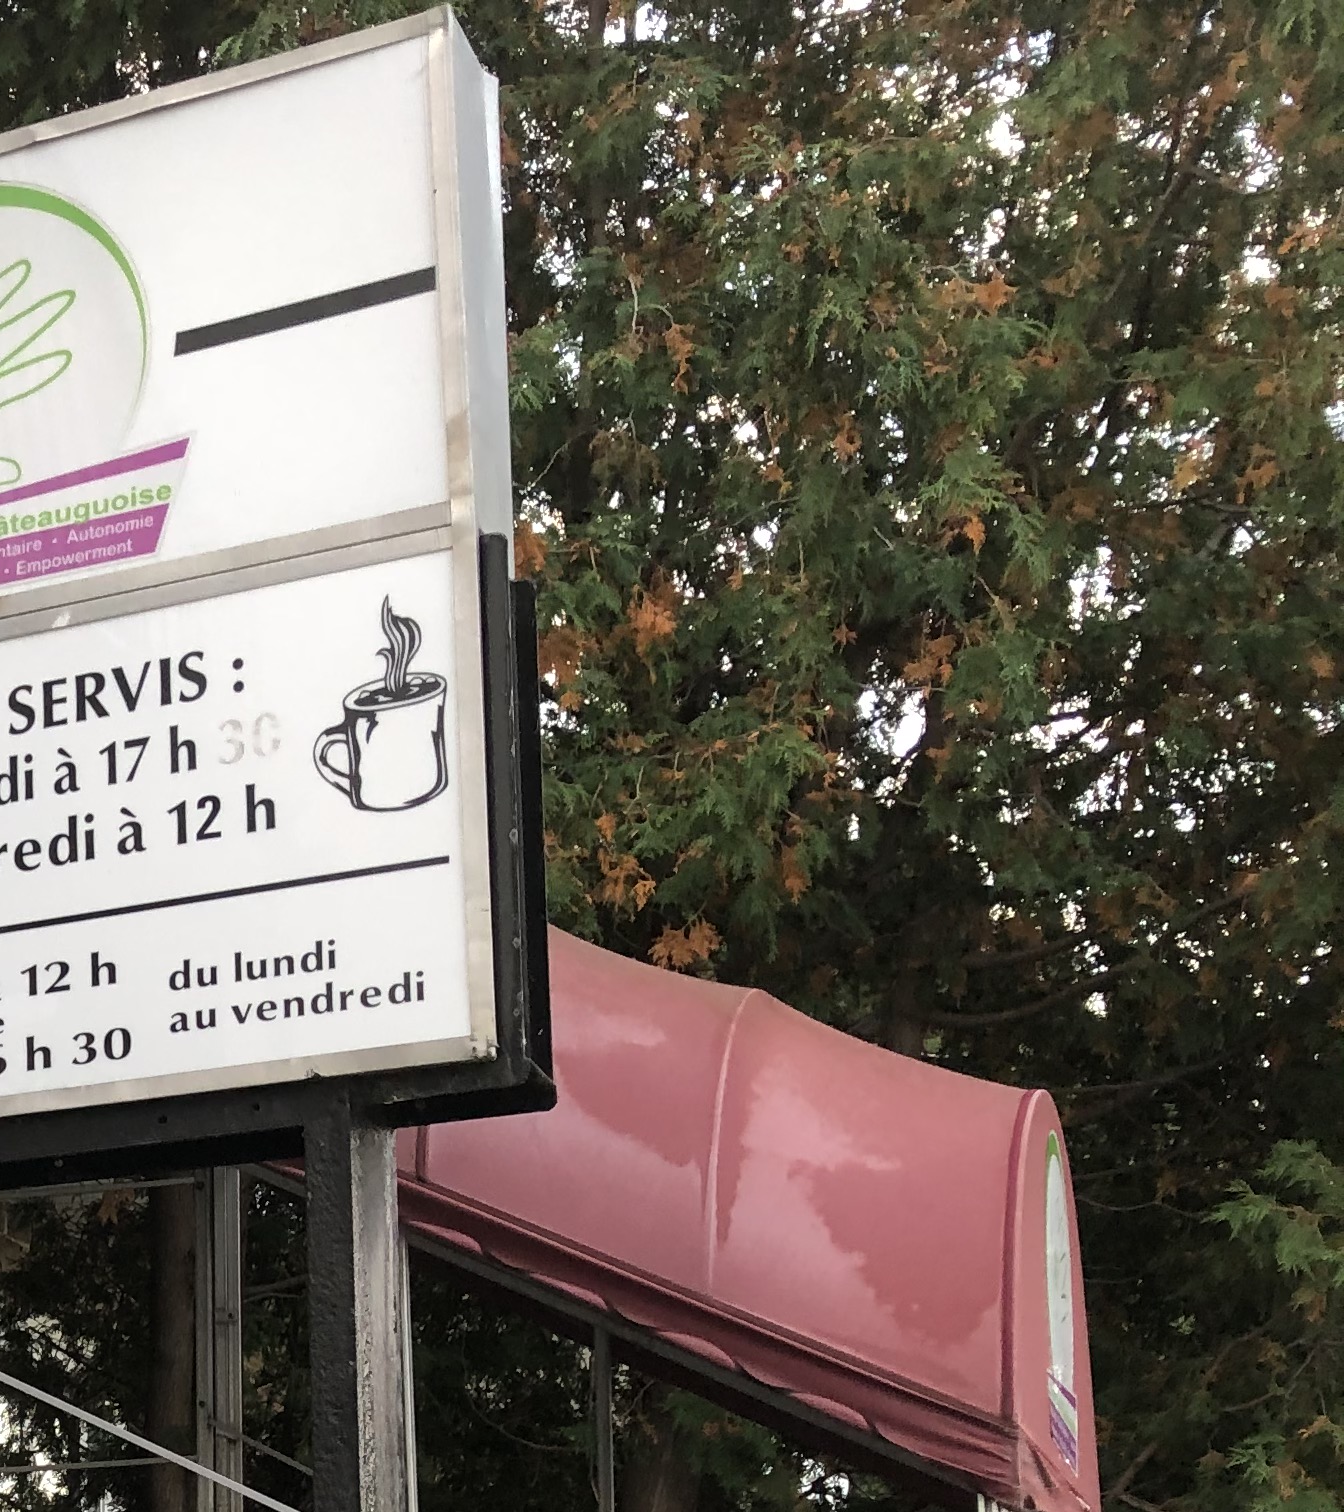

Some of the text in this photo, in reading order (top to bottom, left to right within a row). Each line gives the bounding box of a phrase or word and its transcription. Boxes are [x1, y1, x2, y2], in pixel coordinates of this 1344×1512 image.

[66, 514, 154, 545] Autonomie
[16, 538, 133, 577] Empowerment
[8, 650, 208, 735] SERVIS
[54, 747, 80, 795] à
[99, 736, 151, 786] 17
[169, 724, 198, 774] h
[117, 806, 147, 855] à
[167, 795, 223, 845] 12
[245, 783, 276, 834] h
[20, 960, 72, 998] 12
[90, 951, 117, 987] h
[169, 939, 337, 992] du lundi
[169, 971, 426, 1034] au vendredi
[25, 1036, 52, 1073] h
[71, 1027, 133, 1067] 30
